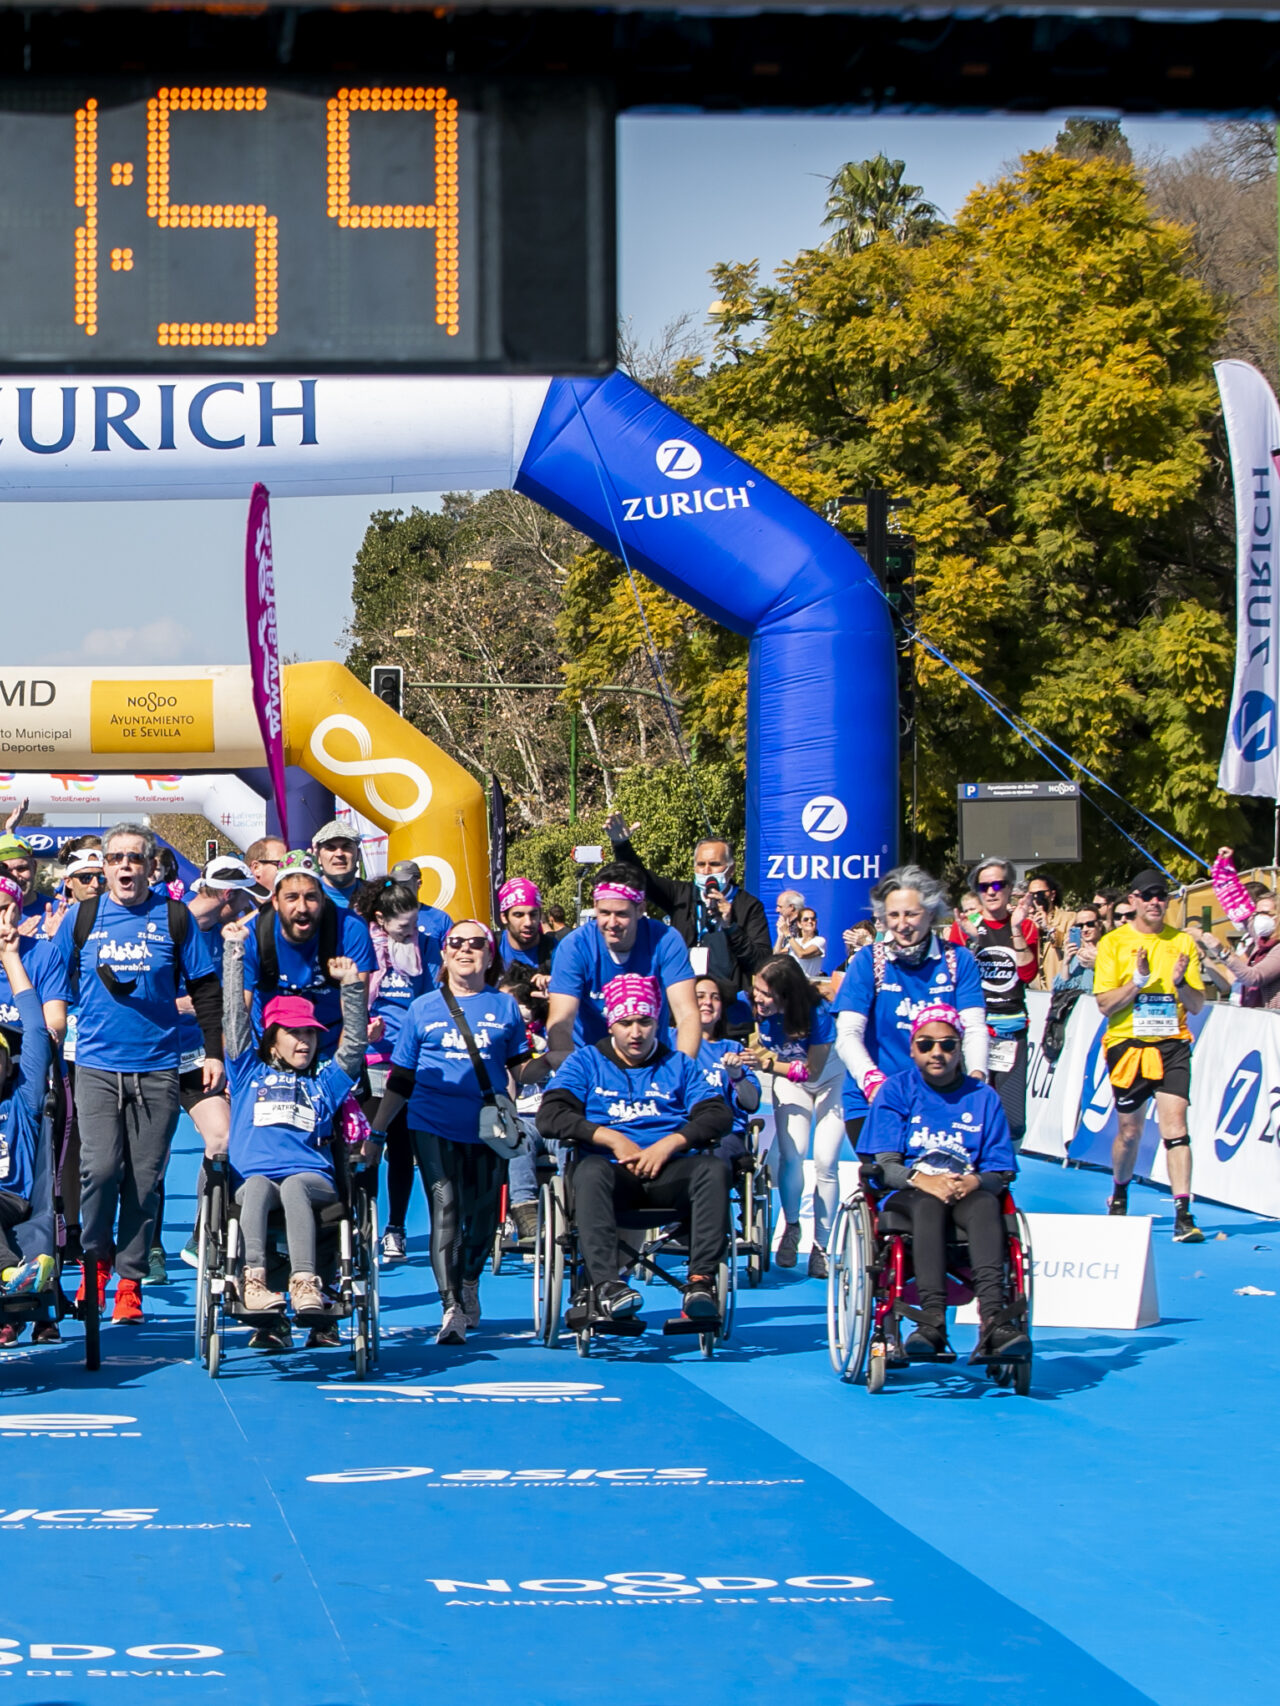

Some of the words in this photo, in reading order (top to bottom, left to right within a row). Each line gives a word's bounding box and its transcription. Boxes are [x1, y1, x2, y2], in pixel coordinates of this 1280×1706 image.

[111, 714, 194, 725] AYUNTAMIENTO
[15, 728, 72, 740] Municipal
[141, 726, 182, 737] SEVILLA
[1, 743, 56, 754] Deportes
[441, 1468, 708, 1480] asics
[86, 1668, 226, 1677] SEVILLA
